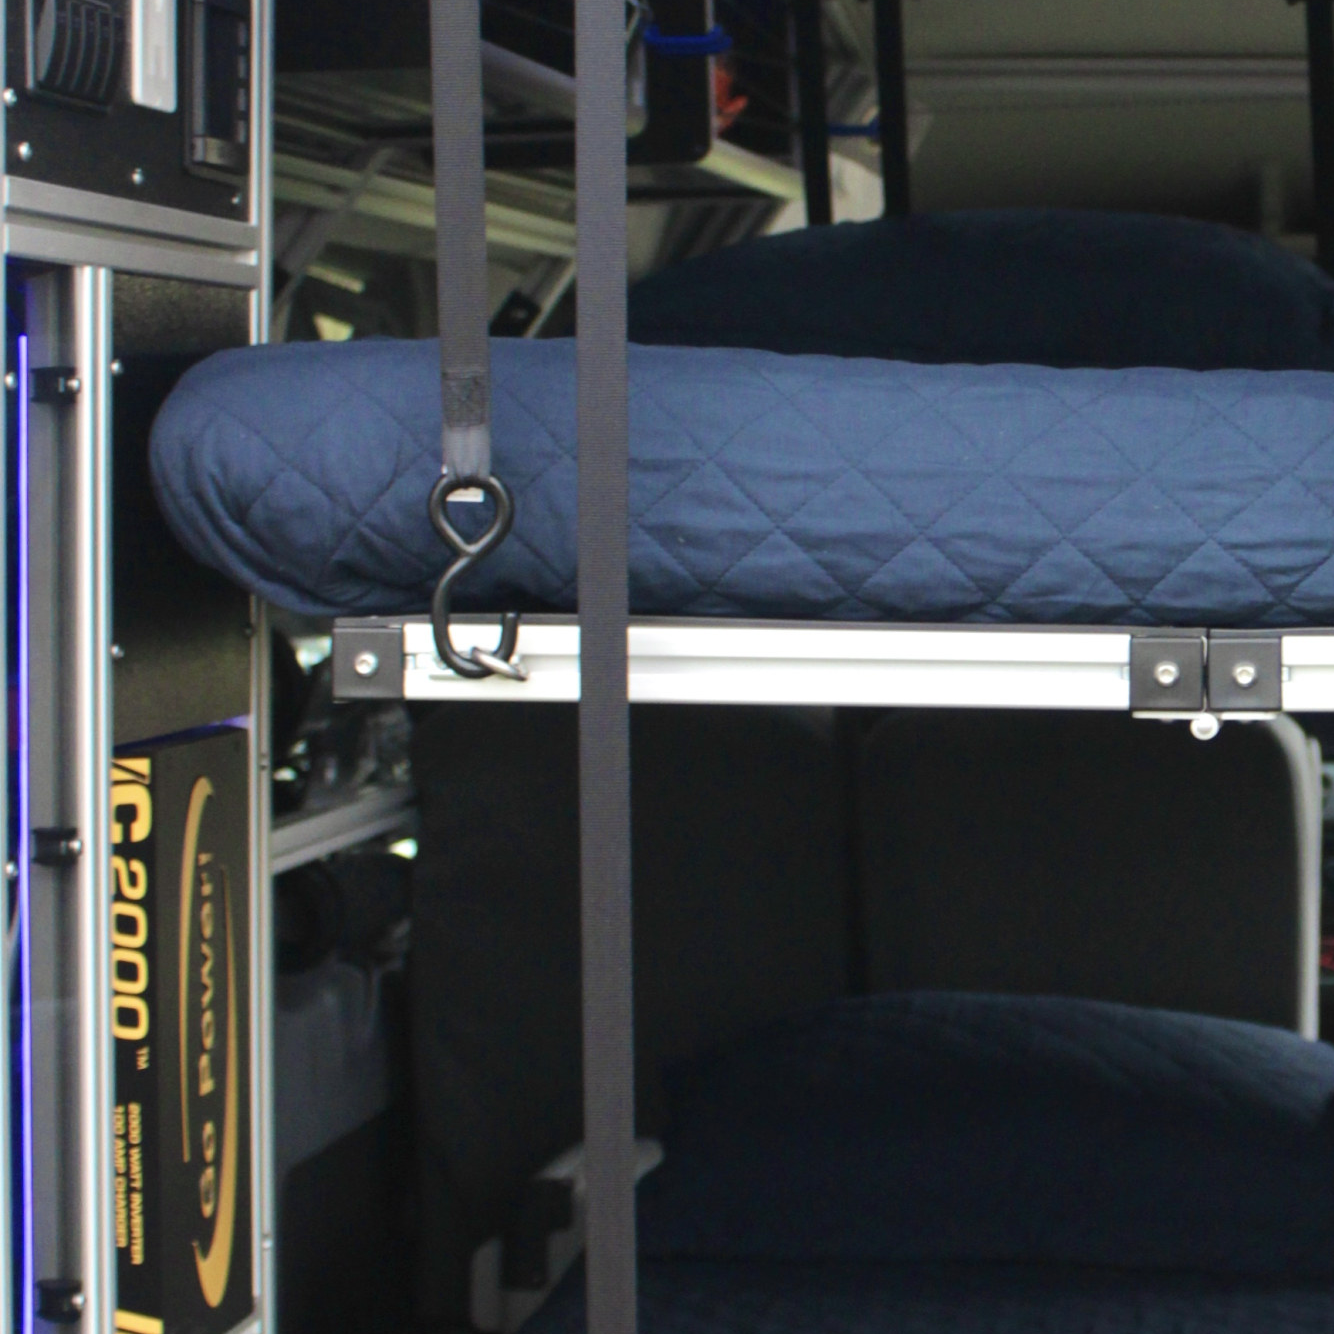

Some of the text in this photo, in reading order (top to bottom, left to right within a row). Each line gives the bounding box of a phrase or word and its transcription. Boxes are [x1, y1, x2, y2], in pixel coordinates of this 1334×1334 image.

[111, 856, 150, 1041] 2000
[113, 1135, 127, 1174] AMP
[128, 1145, 143, 1190] WATT
[115, 1175, 129, 1248] CHARGER
[130, 1191, 144, 1265] INVERTER
